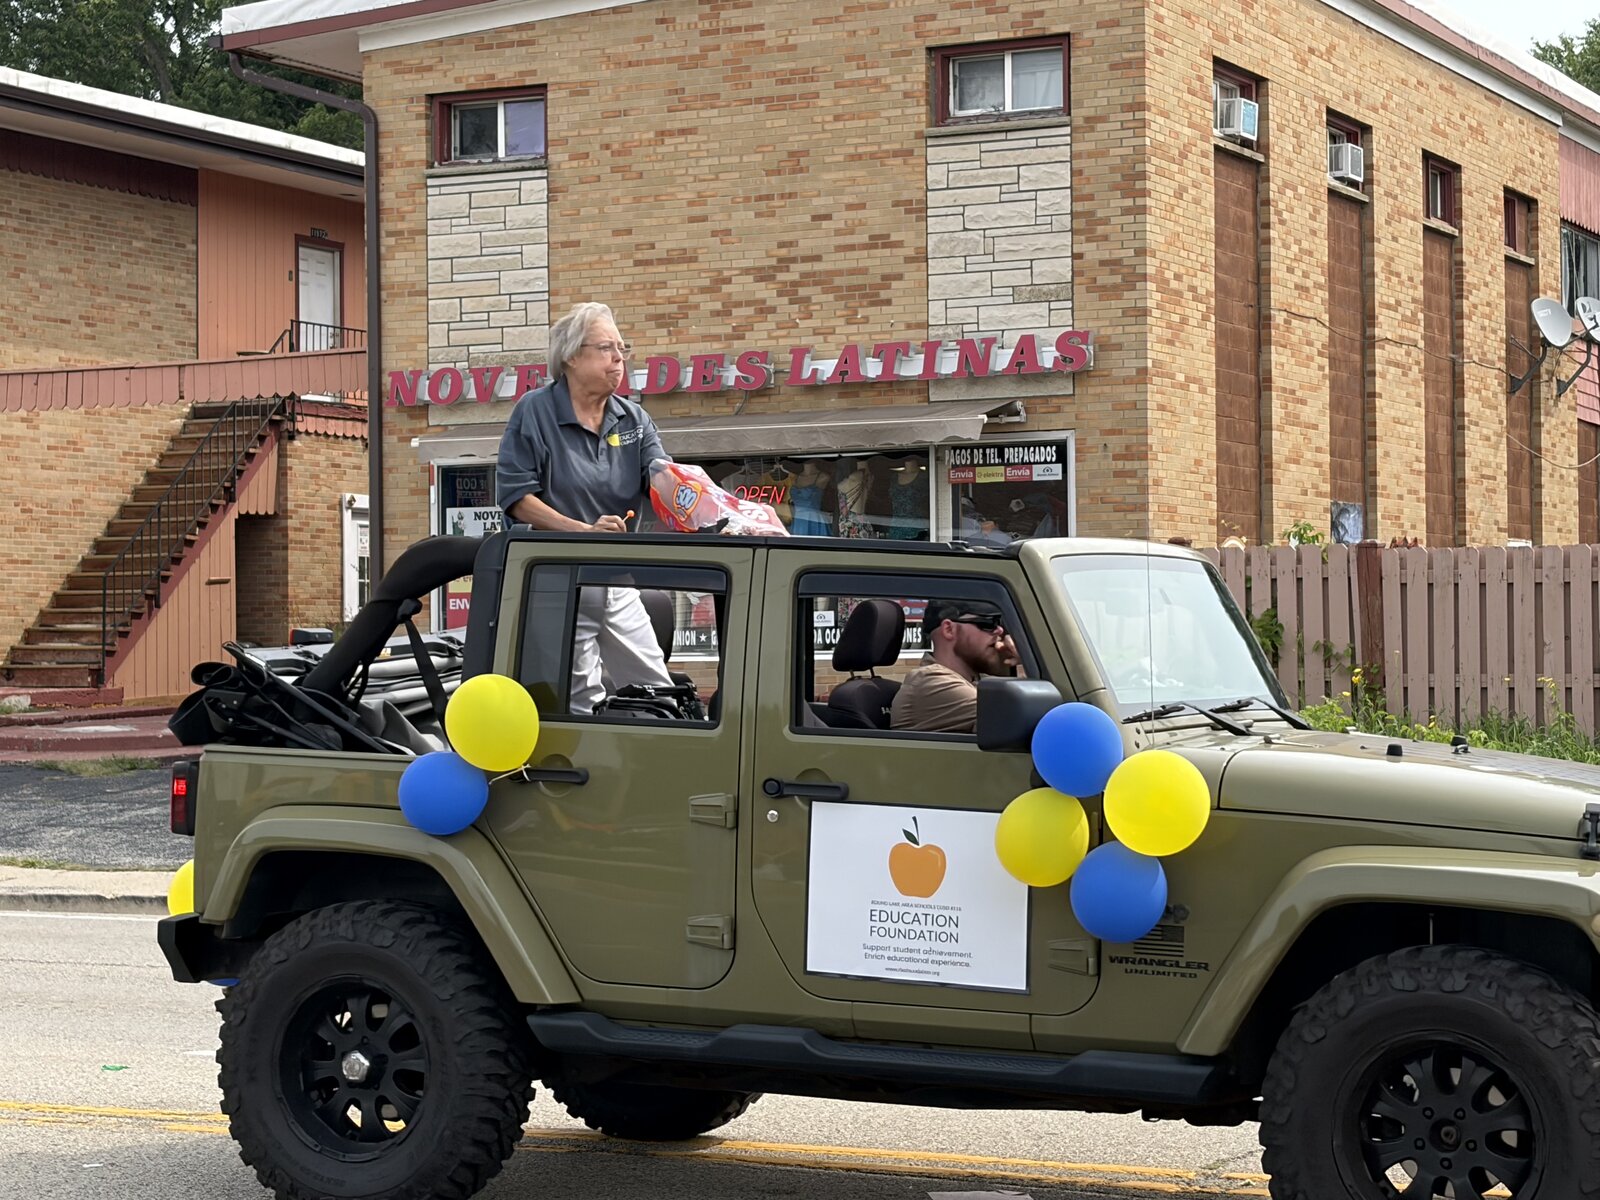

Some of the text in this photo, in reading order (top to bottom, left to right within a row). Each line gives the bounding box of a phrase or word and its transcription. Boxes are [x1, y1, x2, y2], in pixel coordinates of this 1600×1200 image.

[386, 330, 1091, 407] NOVEDES LATINAS
[945, 445, 1057, 465] PAGOS DE TEL. PREPAGADOS
[950, 468, 974, 478] Envía
[1006, 466, 1030, 476] Envía
[735, 485, 787, 505] OPEN
[869, 909, 959, 929] EDUCATION
[869, 925, 959, 944] FOUNDATION
[863, 943, 974, 959] Support student achievement.
[864, 952, 972, 967] Enrich educational experience.
[1108, 955, 1210, 972] WRANGLER
[1124, 967, 1198, 979] UNLIMITED
